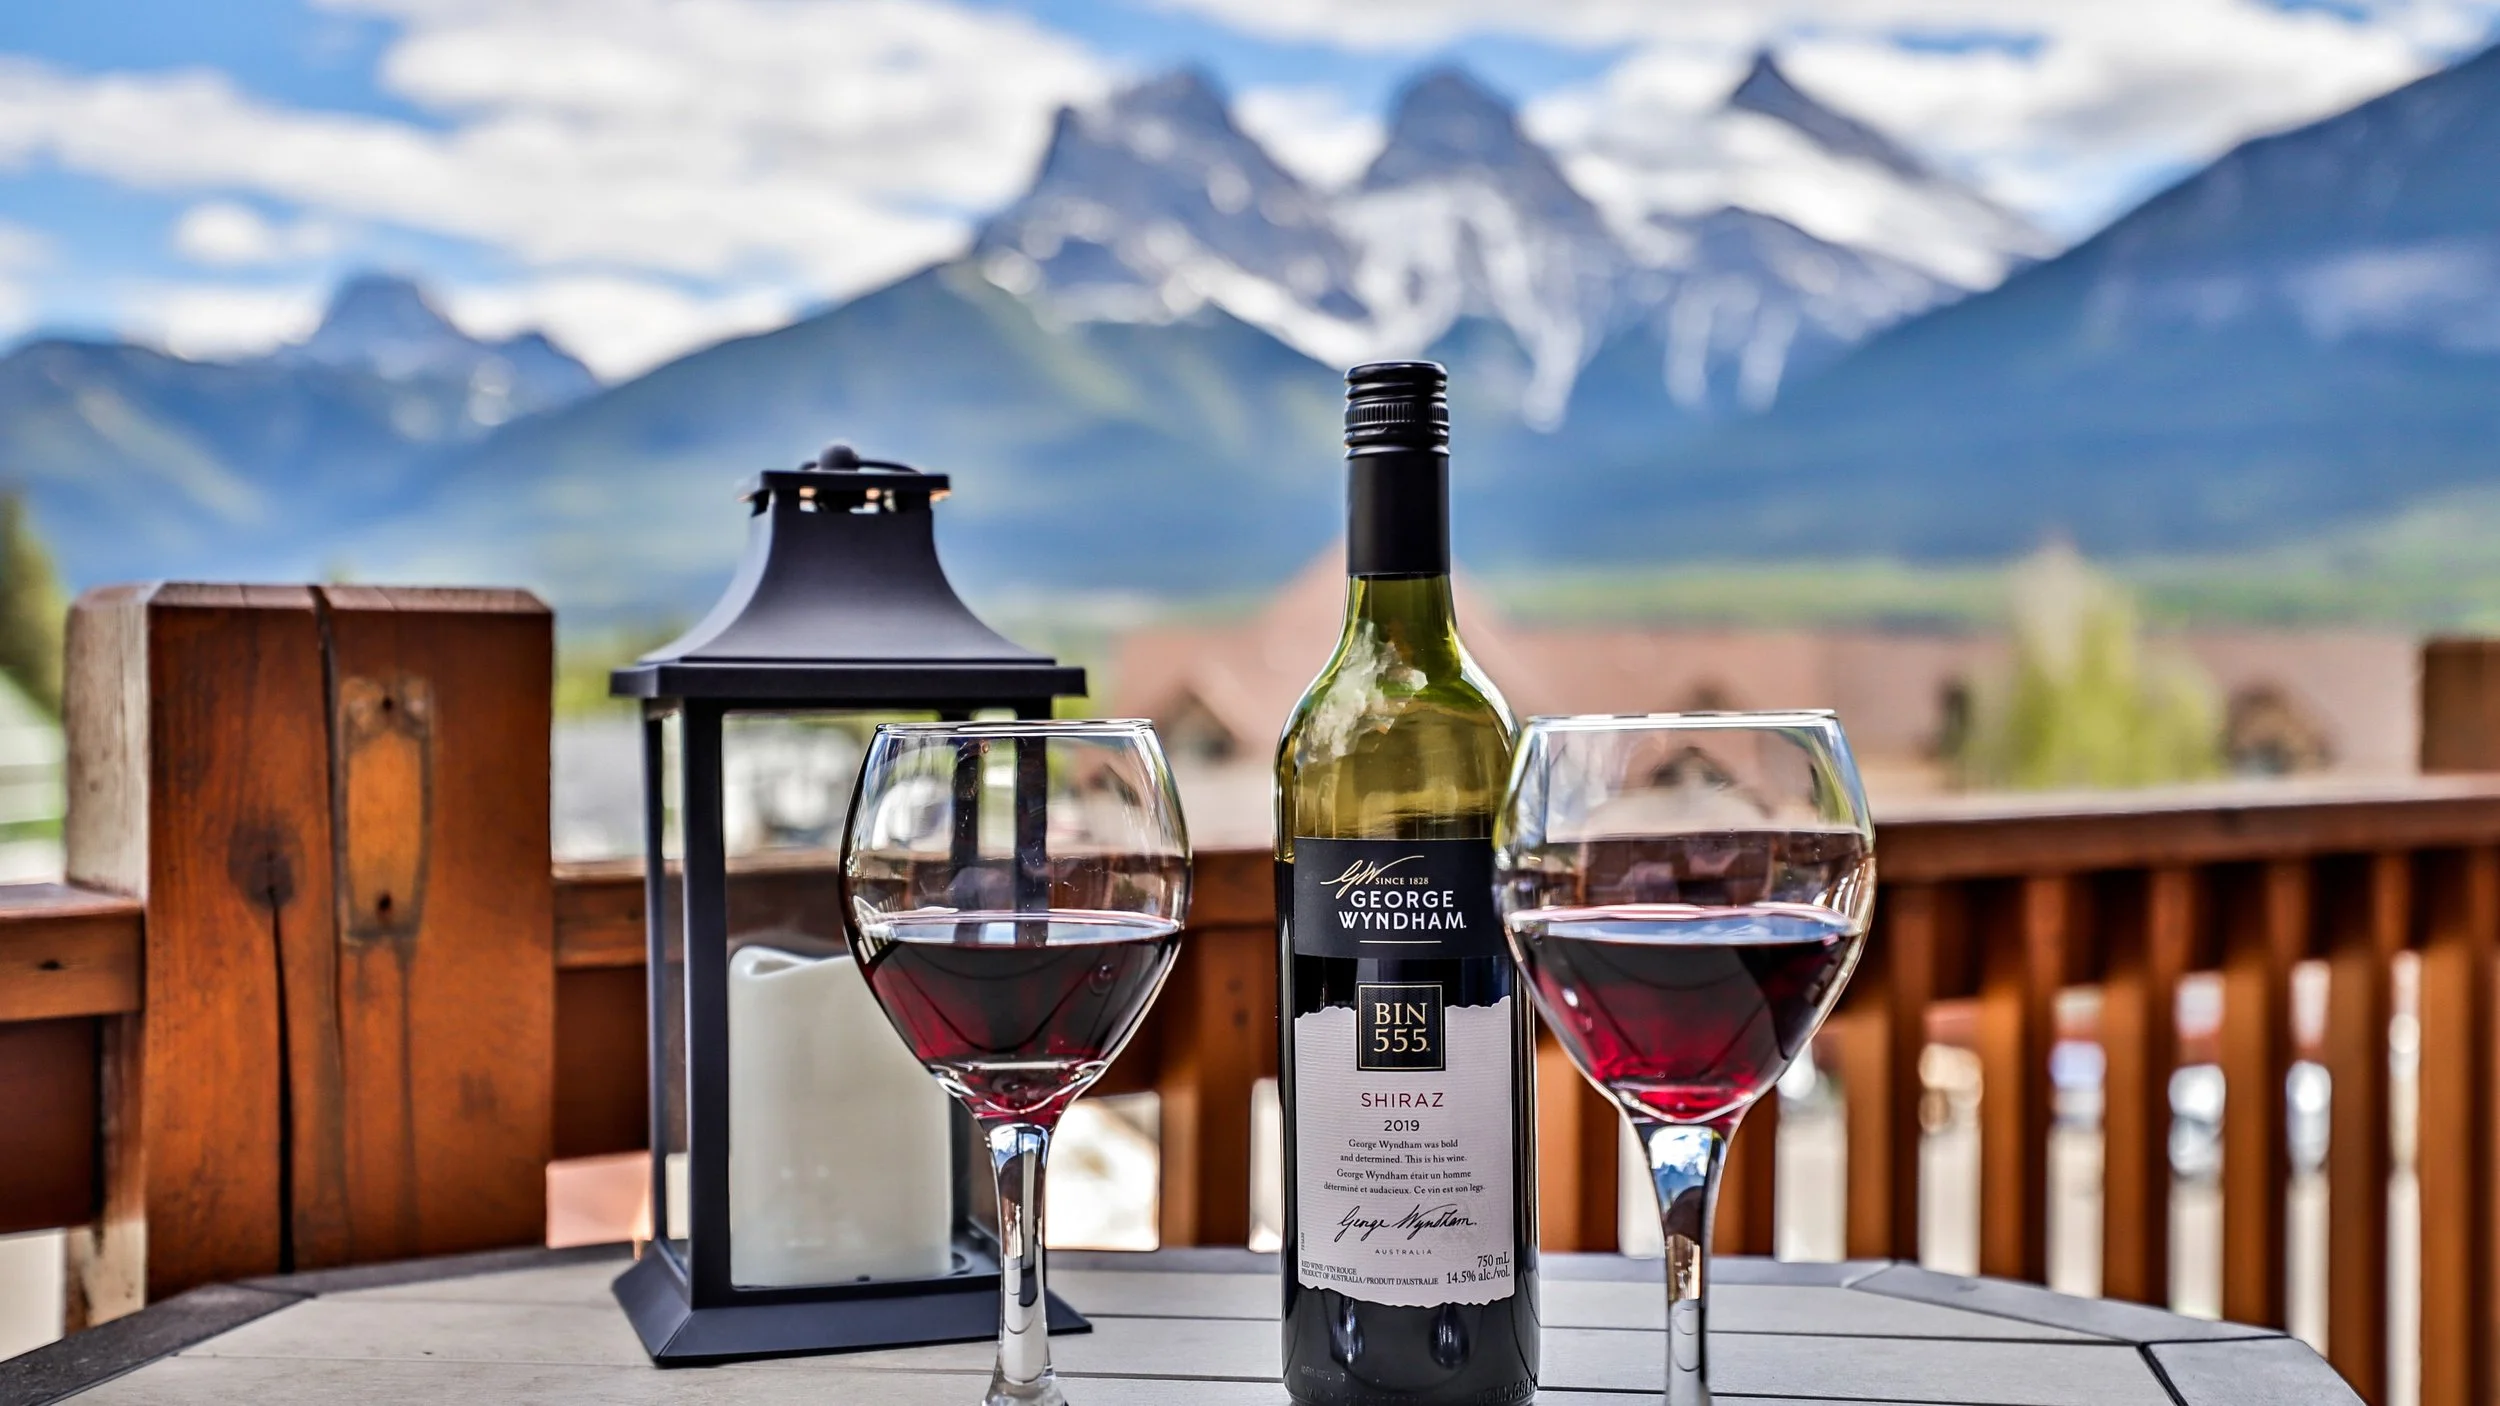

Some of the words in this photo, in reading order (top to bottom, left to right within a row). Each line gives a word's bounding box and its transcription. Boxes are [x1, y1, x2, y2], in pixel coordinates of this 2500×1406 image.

[1375, 877, 1405, 885] SINCE
[1409, 877, 1429, 885] 1828
[1350, 890, 1454, 908] GEORGE
[1374, 1002, 1428, 1025] BIN
[1361, 1092, 1444, 1108] SHIRAZ
[1384, 1119, 1420, 1132] 2019
[1348, 1138, 1377, 1151] George
[1378, 1140, 1422, 1152] Wyndham
[1441, 1139, 1459, 1148] bold
[1340, 1153, 1354, 1162] and
[1355, 1154, 1403, 1164] determined.
[1404, 1154, 1422, 1164] This
[1424, 1155, 1431, 1164] is
[1433, 1154, 1445, 1163] his
[1446, 1154, 1468, 1163] wine.
[1336, 1168, 1364, 1181] George
[1365, 1170, 1409, 1182] Wyndham
[1410, 1171, 1429, 1180] était
[1443, 1170, 1472, 1179] homme
[1323, 1181, 1359, 1193] déterminé
[1369, 1185, 1412, 1195] audacieux.
[1413, 1185, 1426, 1195] Ce
[1427, 1185, 1441, 1194] vin
[1334, 1205, 1390, 1243] George
[1477, 1254, 1494, 1268] 750
[1495, 1251, 1510, 1265] mL
[1301, 1268, 1322, 1278] PRODUCT
[1322, 1272, 1330, 1280] OF
[1336, 1267, 1358, 1275] ROUGE
[1446, 1270, 1476, 1284] 14.5%
